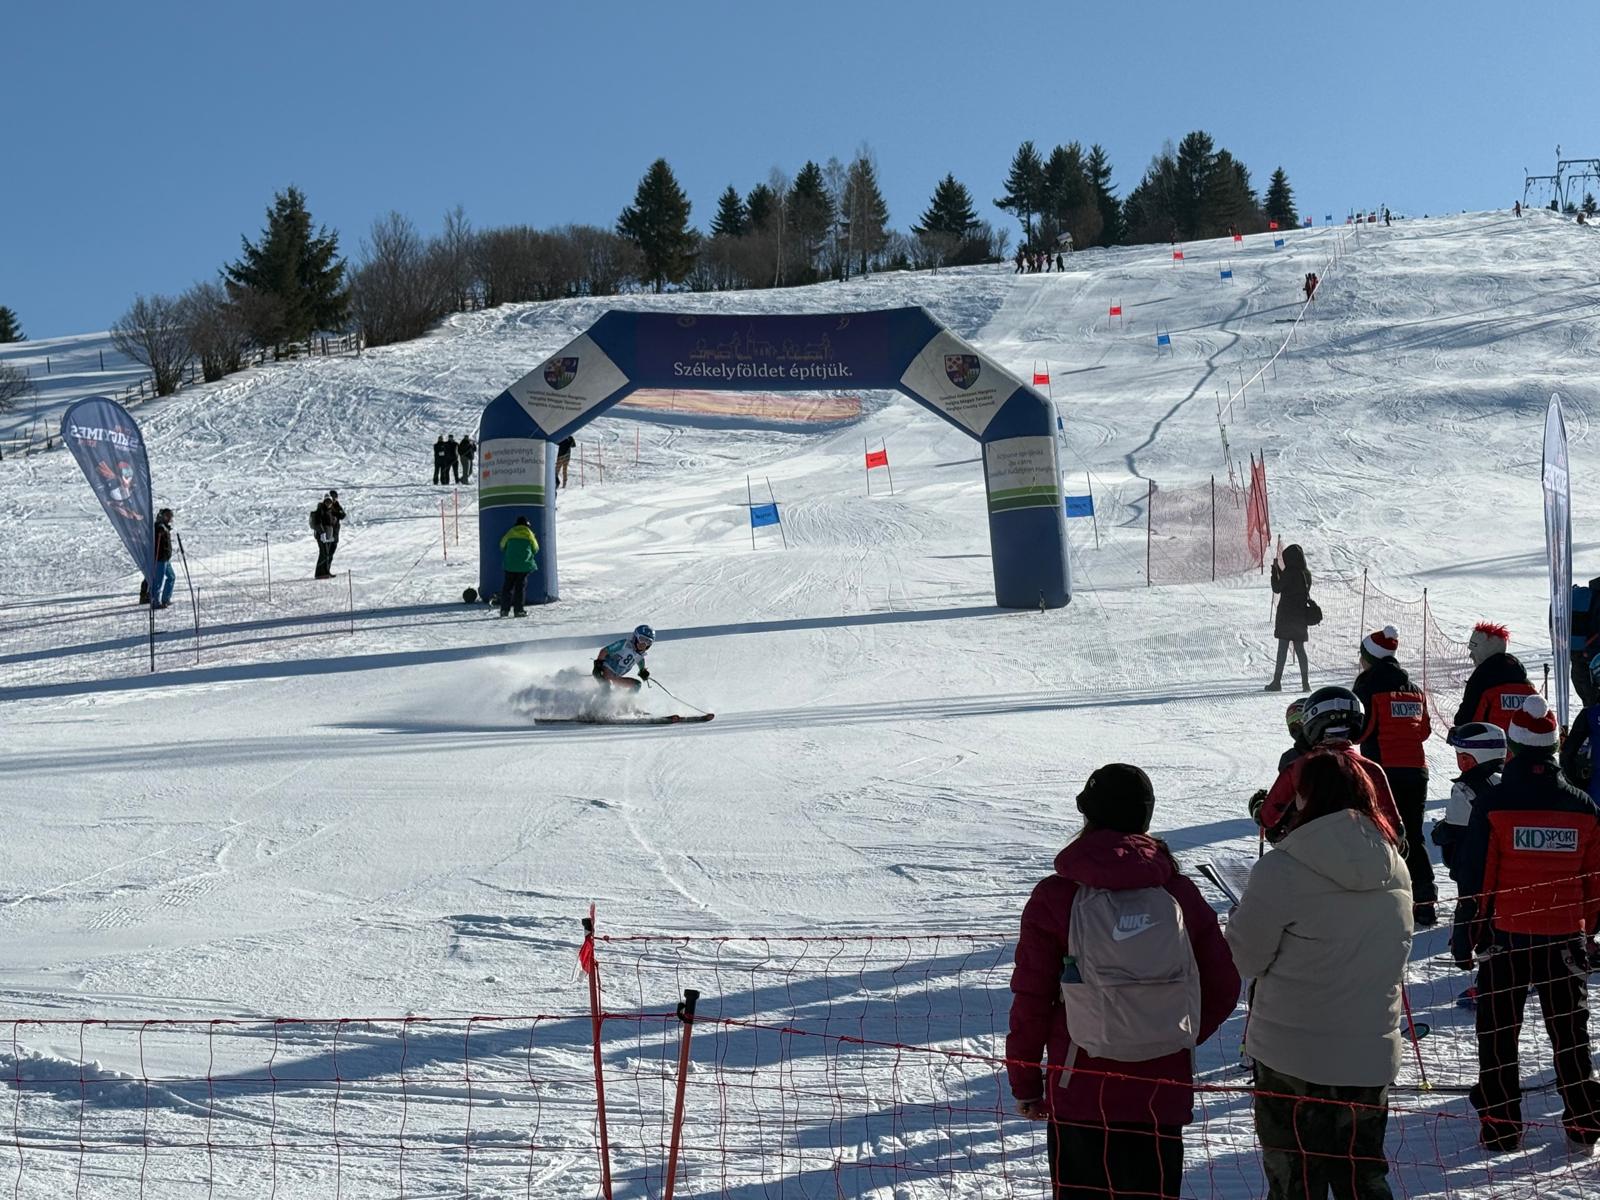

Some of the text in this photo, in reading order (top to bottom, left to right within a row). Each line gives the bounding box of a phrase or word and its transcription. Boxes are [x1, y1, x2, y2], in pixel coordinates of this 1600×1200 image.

[674, 361, 853, 380] Székelyföldet építjük.
[1392, 703, 1408, 716] KID
[1502, 695, 1520, 709] KID
[1515, 829, 1545, 849] KID
[1545, 829, 1576, 842] SPORT
[1118, 913, 1151, 929] NIKE
